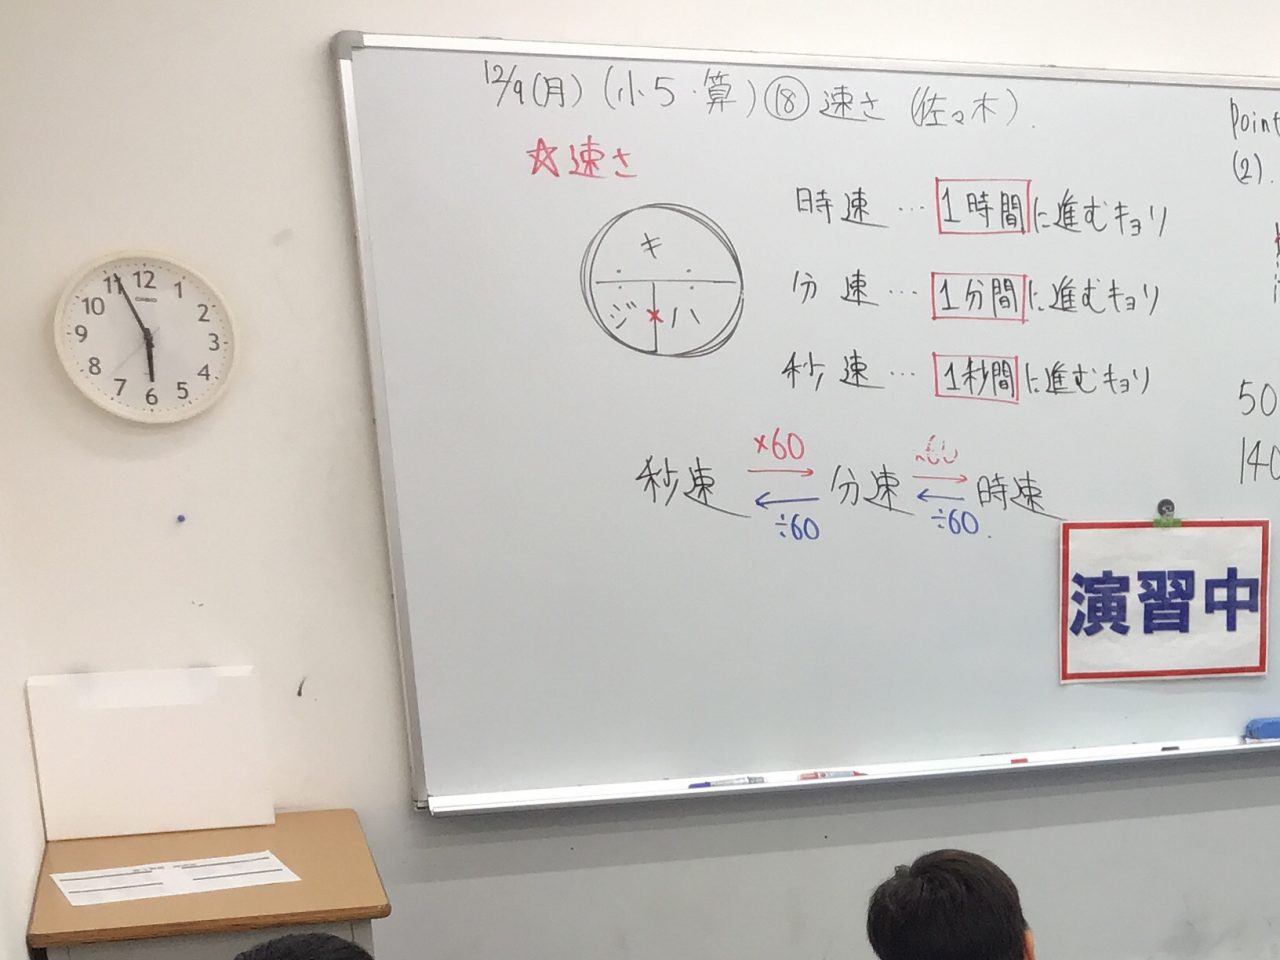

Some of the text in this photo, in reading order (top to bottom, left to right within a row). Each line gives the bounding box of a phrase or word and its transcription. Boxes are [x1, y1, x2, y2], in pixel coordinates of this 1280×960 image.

[819, 85, 886, 121] 速さ
[1231, 97, 1280, 140] Point
[568, 134, 639, 179] 速さ
[640, 232, 663, 259] キ
[132, 270, 157, 289] 12
[173, 281, 183, 299] 1
[81, 296, 105, 316] 10
[196, 303, 211, 322] 2
[74, 324, 88, 343] 9
[208, 332, 221, 351] 3
[88, 356, 102, 375] 8
[196, 363, 212, 381] 4
[113, 378, 127, 396] 7
[145, 387, 159, 406] 6
[176, 381, 190, 400] 5
[752, 427, 805, 461] ×60
[636, 457, 751, 519] 秒速
[830, 463, 915, 516] 分速
[977, 473, 1067, 521] 時速
[774, 513, 821, 542] ÷60
[1069, 566, 1261, 636] 演習中
